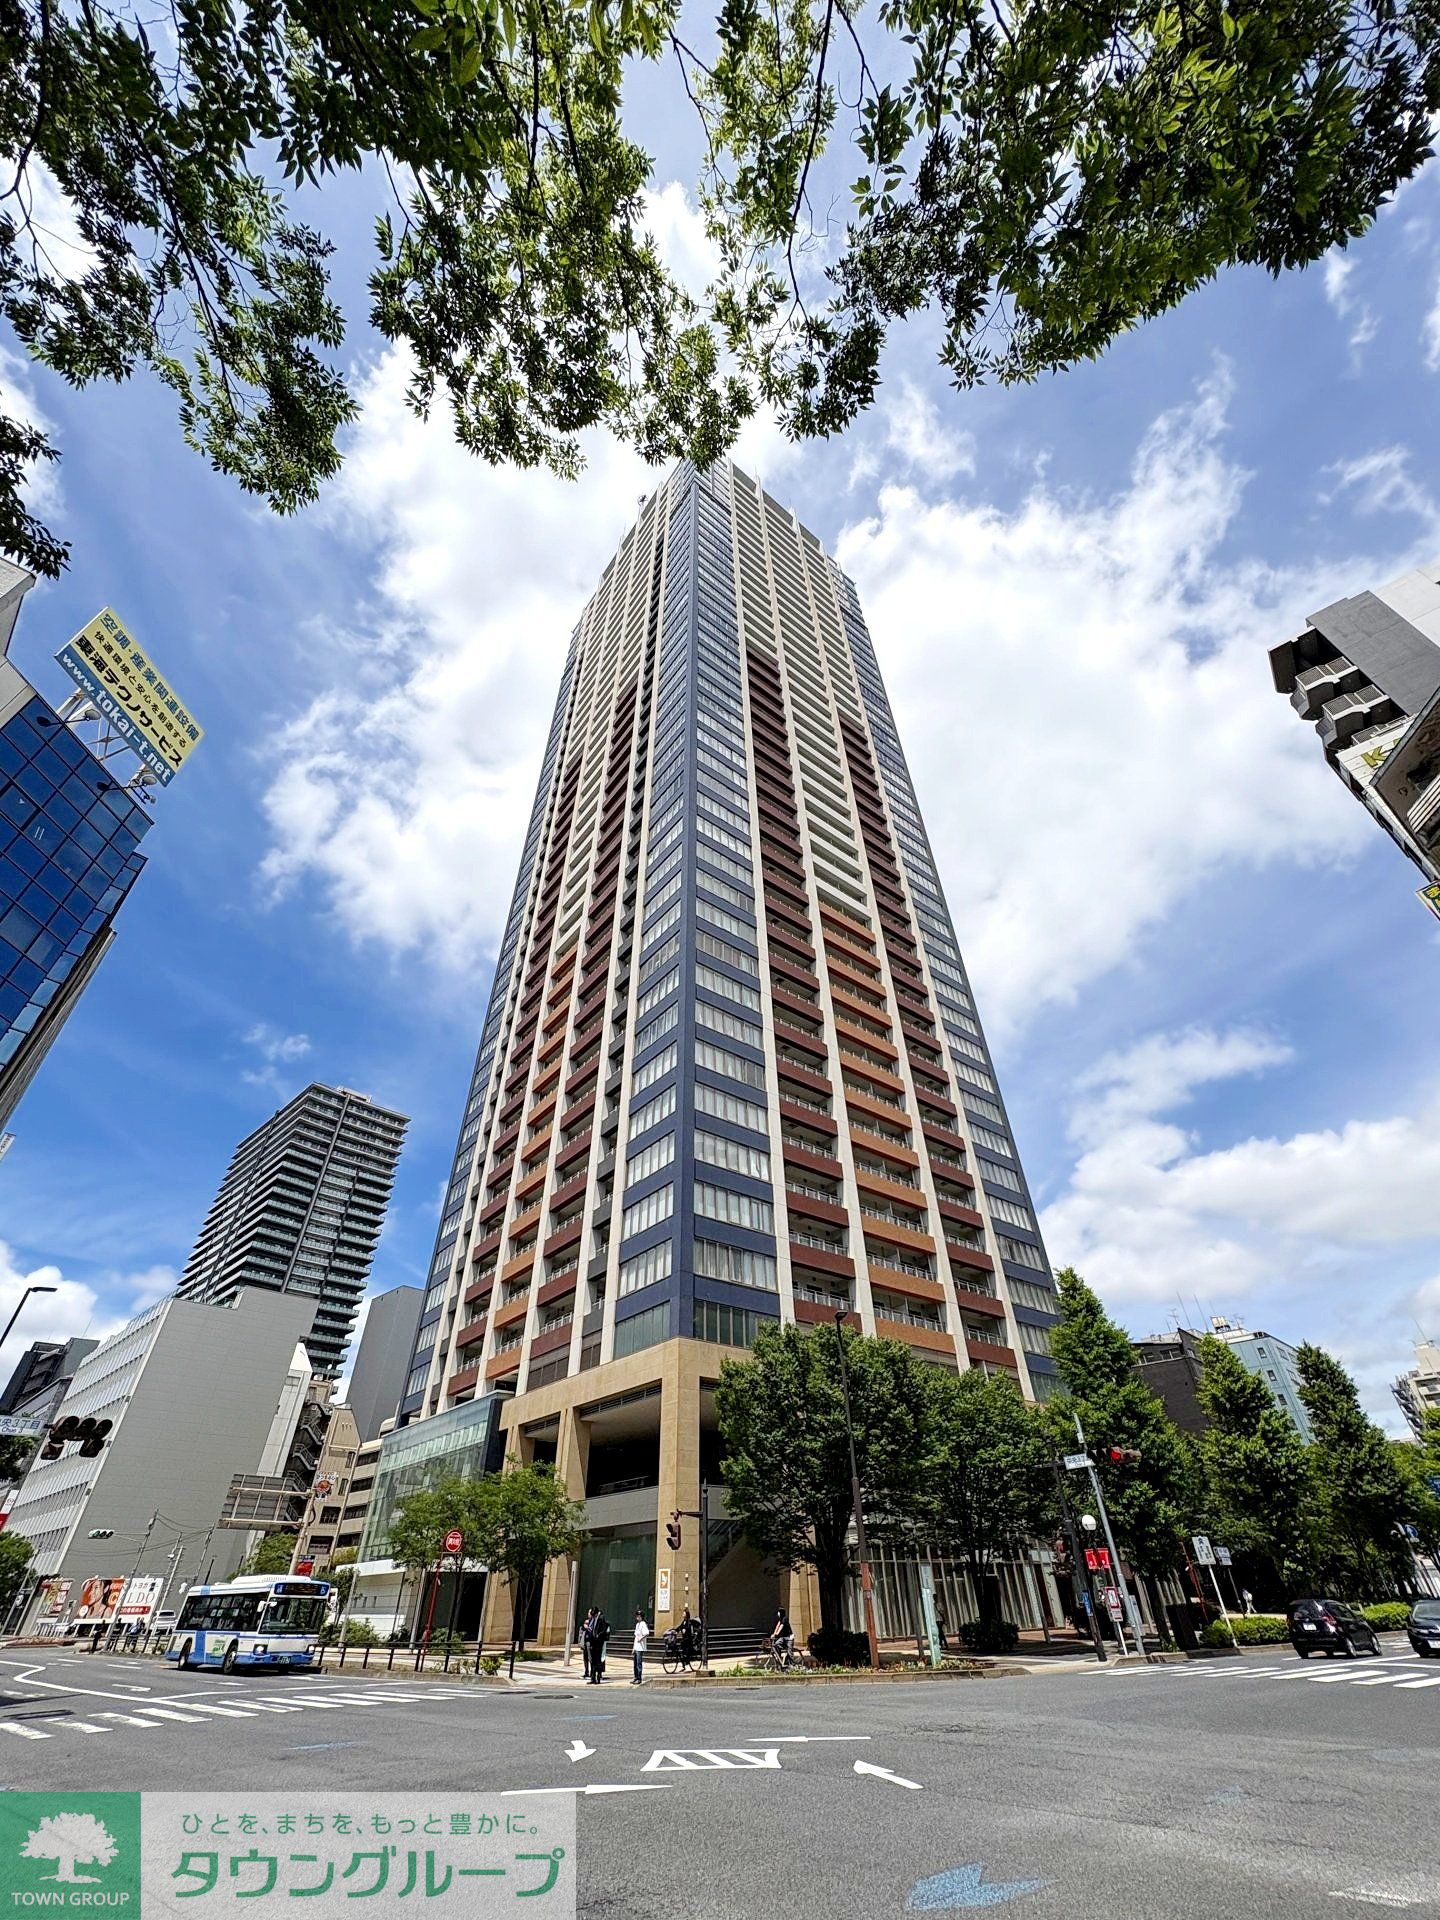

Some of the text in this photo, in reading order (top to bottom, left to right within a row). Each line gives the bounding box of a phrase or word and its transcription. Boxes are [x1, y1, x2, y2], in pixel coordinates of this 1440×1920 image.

[62, 653, 171, 783] www.tokai-t.net
[75, 634, 184, 768] 東海テクノサービス
[0, 1418, 40, 1430] 央3丁目
